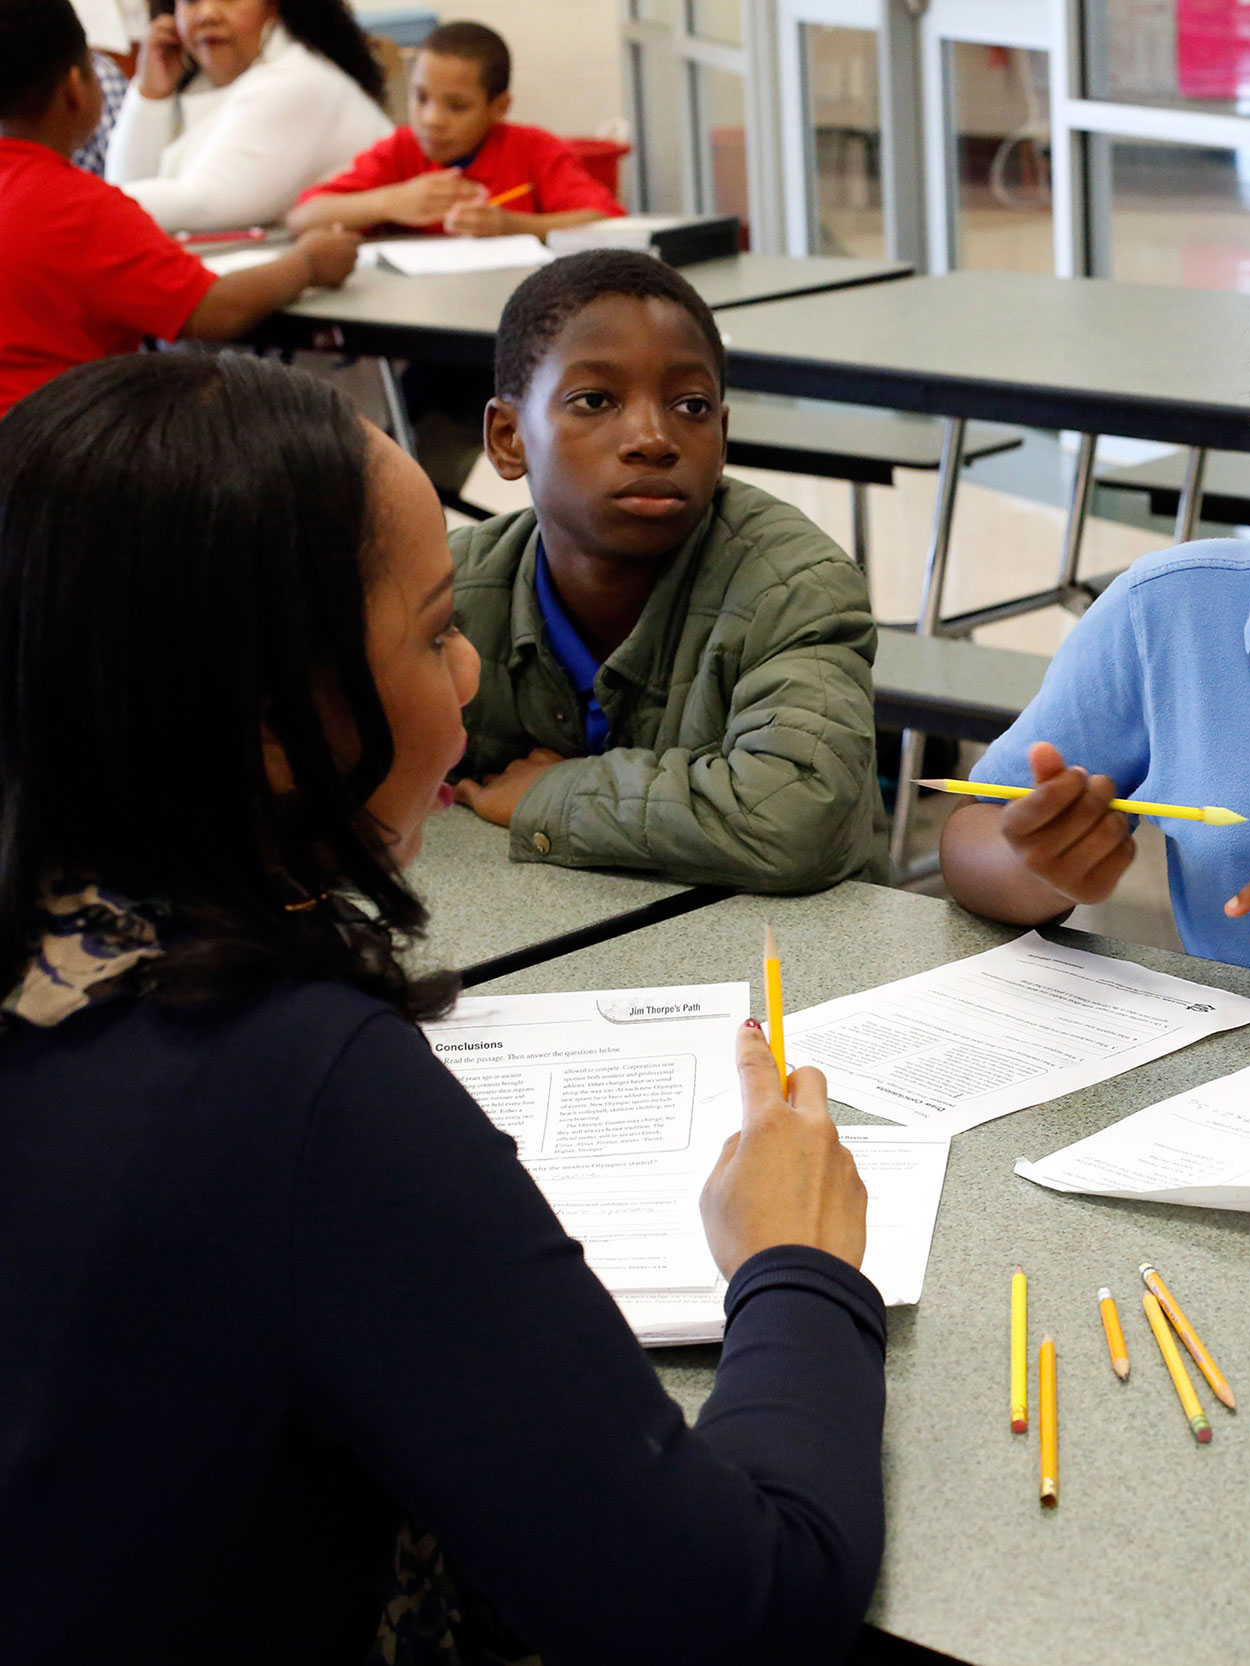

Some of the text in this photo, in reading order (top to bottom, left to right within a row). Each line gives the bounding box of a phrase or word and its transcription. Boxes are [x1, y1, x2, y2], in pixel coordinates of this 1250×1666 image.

[629, 1002, 701, 1017] Jim Thorpe's Path
[434, 1040, 504, 1052] Conclusions
[463, 1056, 475, 1064] the
[507, 1053, 525, 1061] Then
[564, 1049, 598, 1058] questions
